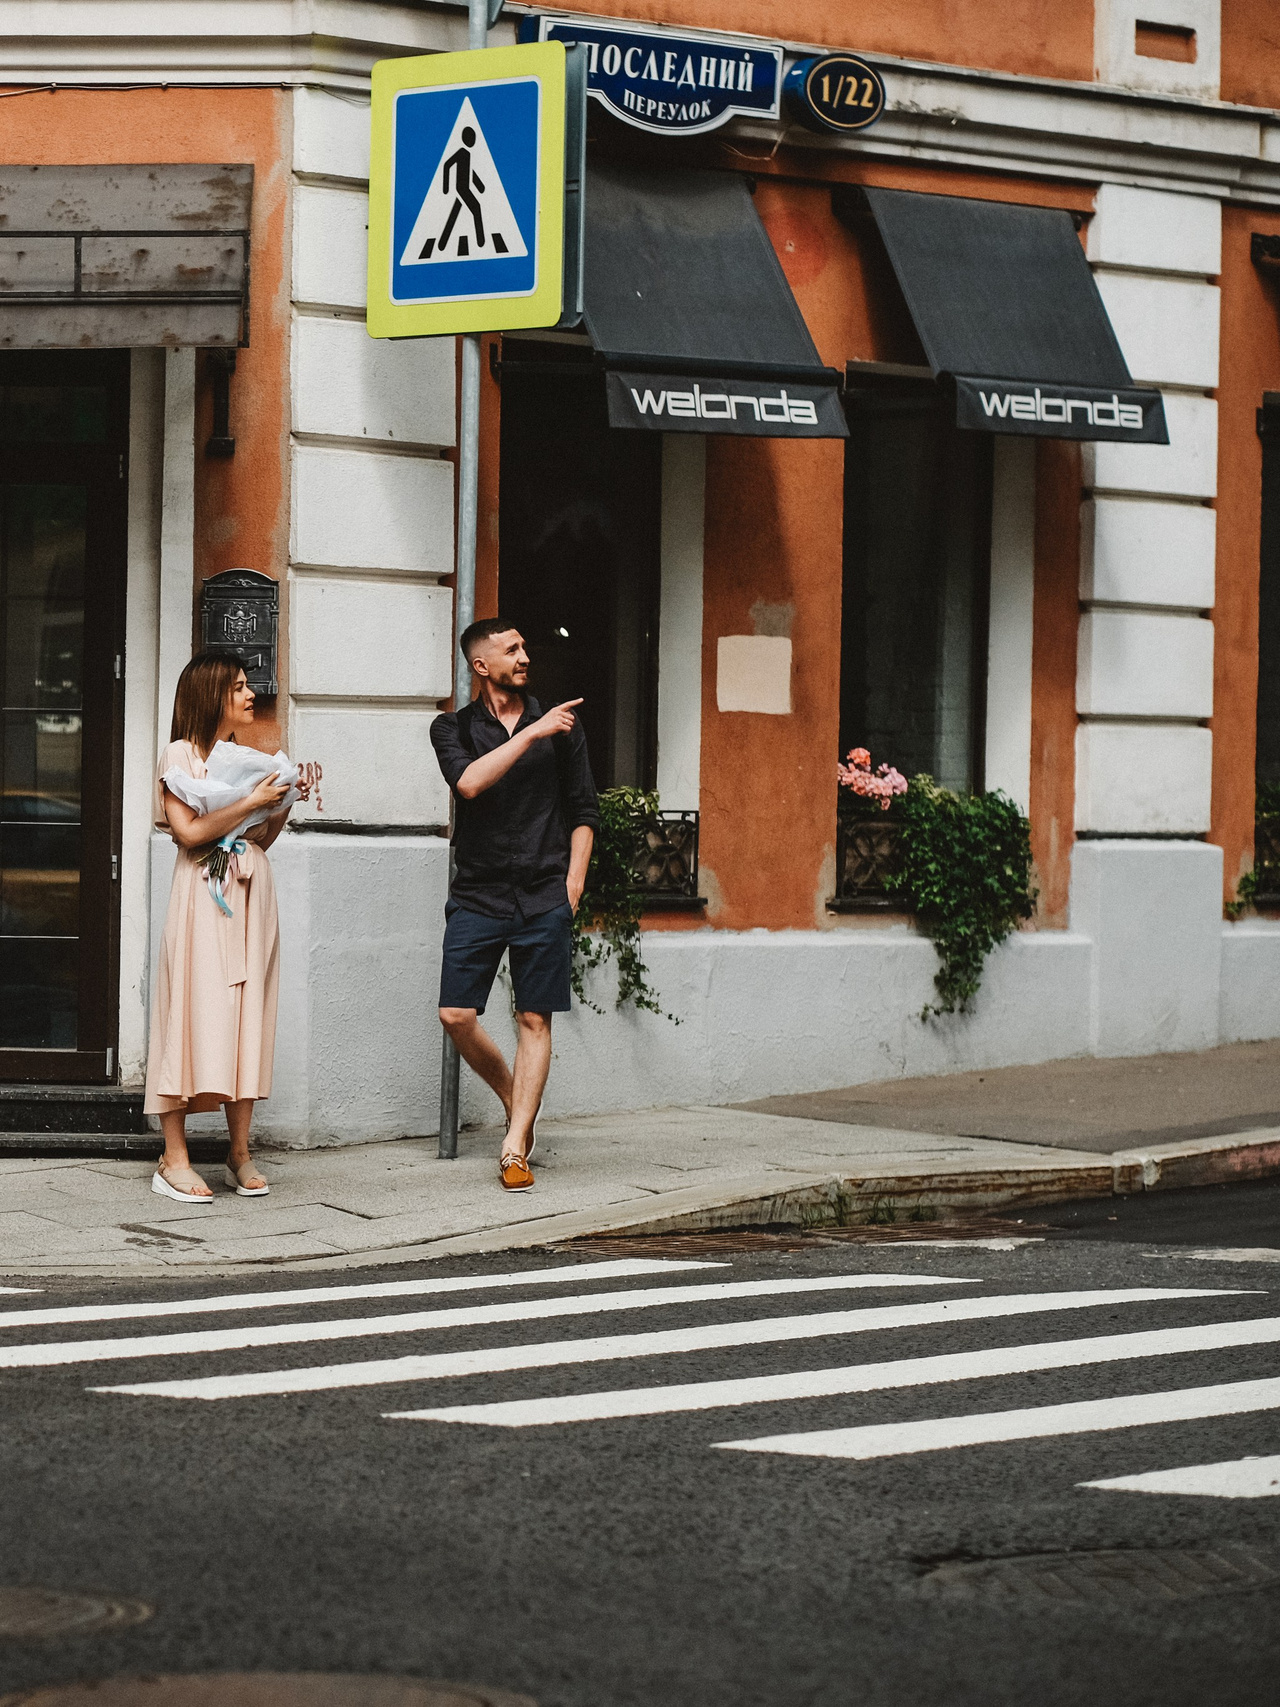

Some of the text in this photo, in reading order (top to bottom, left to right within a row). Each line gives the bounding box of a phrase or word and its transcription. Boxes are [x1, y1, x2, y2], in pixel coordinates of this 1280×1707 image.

[624, 88, 711, 121] ПЕРЕУЛОК
[821, 74, 874, 109] 1/22
[630, 383, 819, 425] welonda
[979, 387, 1144, 429] welonda
